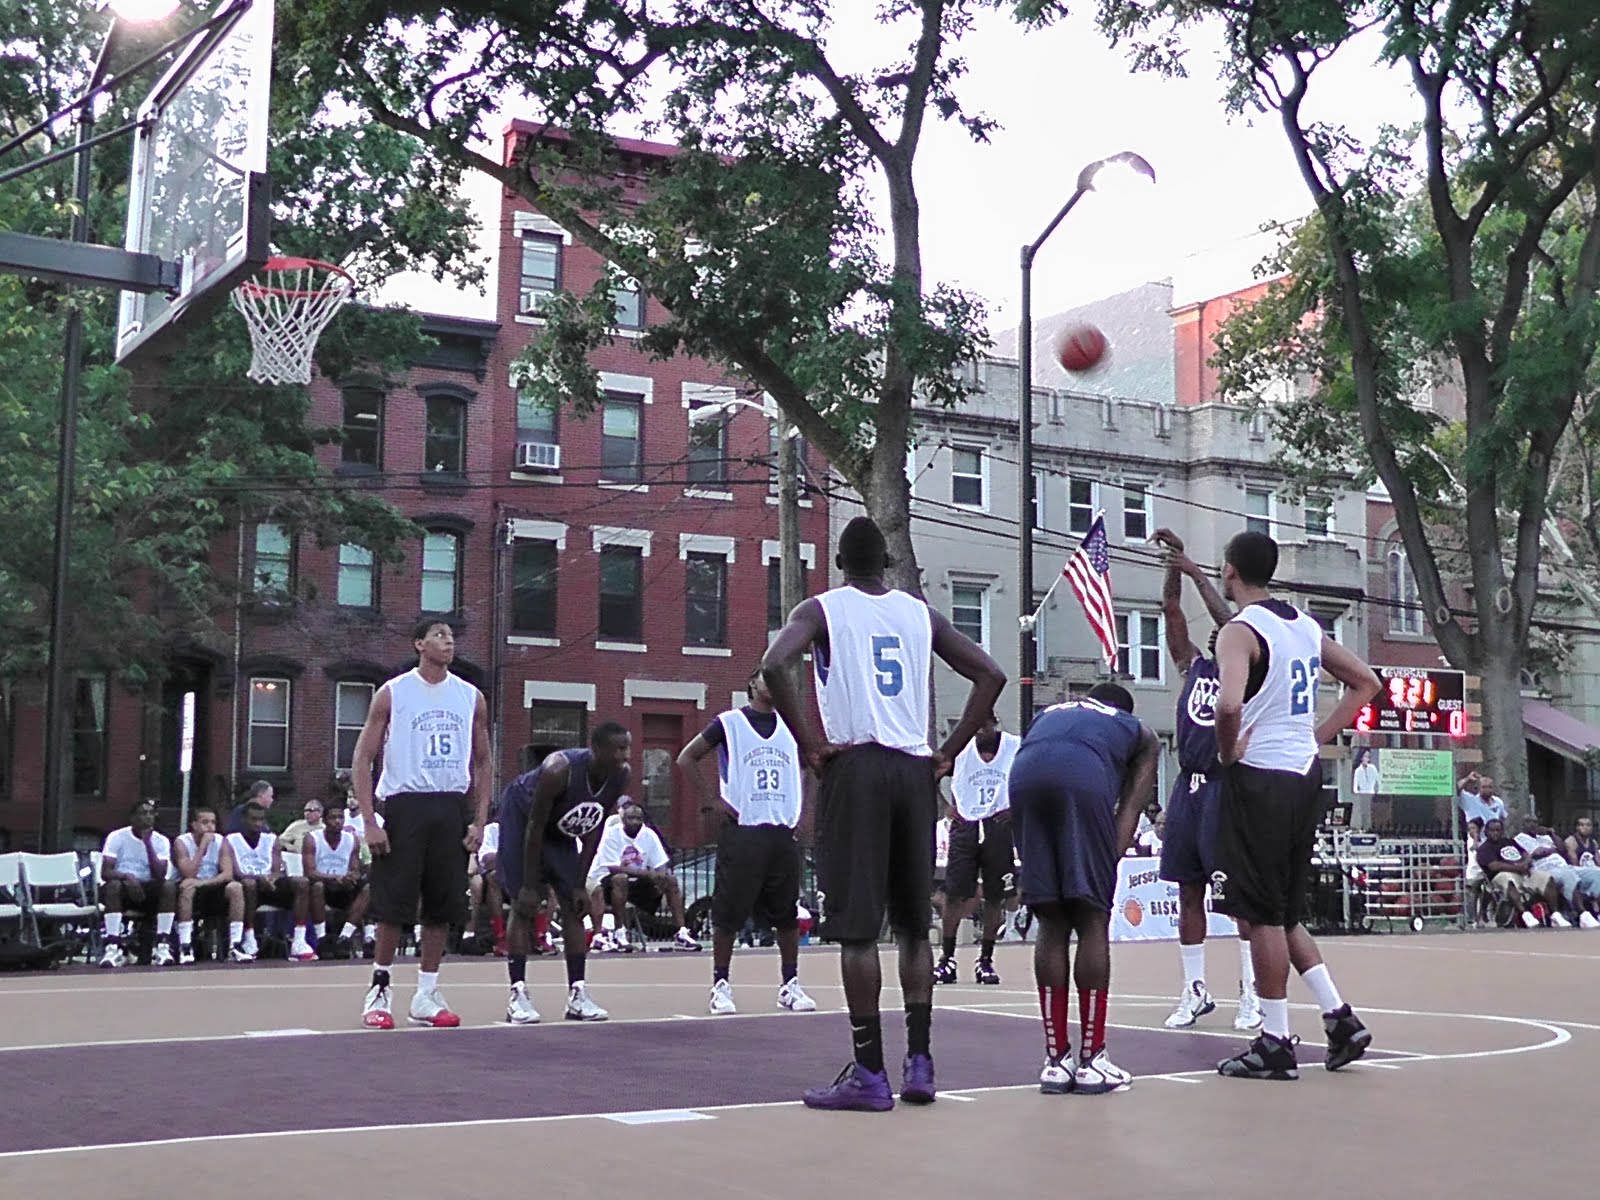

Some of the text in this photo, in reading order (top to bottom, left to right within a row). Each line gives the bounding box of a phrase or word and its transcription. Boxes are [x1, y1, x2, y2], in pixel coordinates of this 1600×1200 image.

[872, 636, 903, 697] 5
[1437, 699, 1463, 711] GUEST
[1356, 705, 1371, 731] 2
[1450, 711, 1463, 735] 0
[430, 734, 451, 756] 15
[757, 769, 779, 790] 23
[979, 788, 996, 806] 13
[1128, 870, 1160, 889] Jersey
[1150, 900, 1179, 916] BASK
